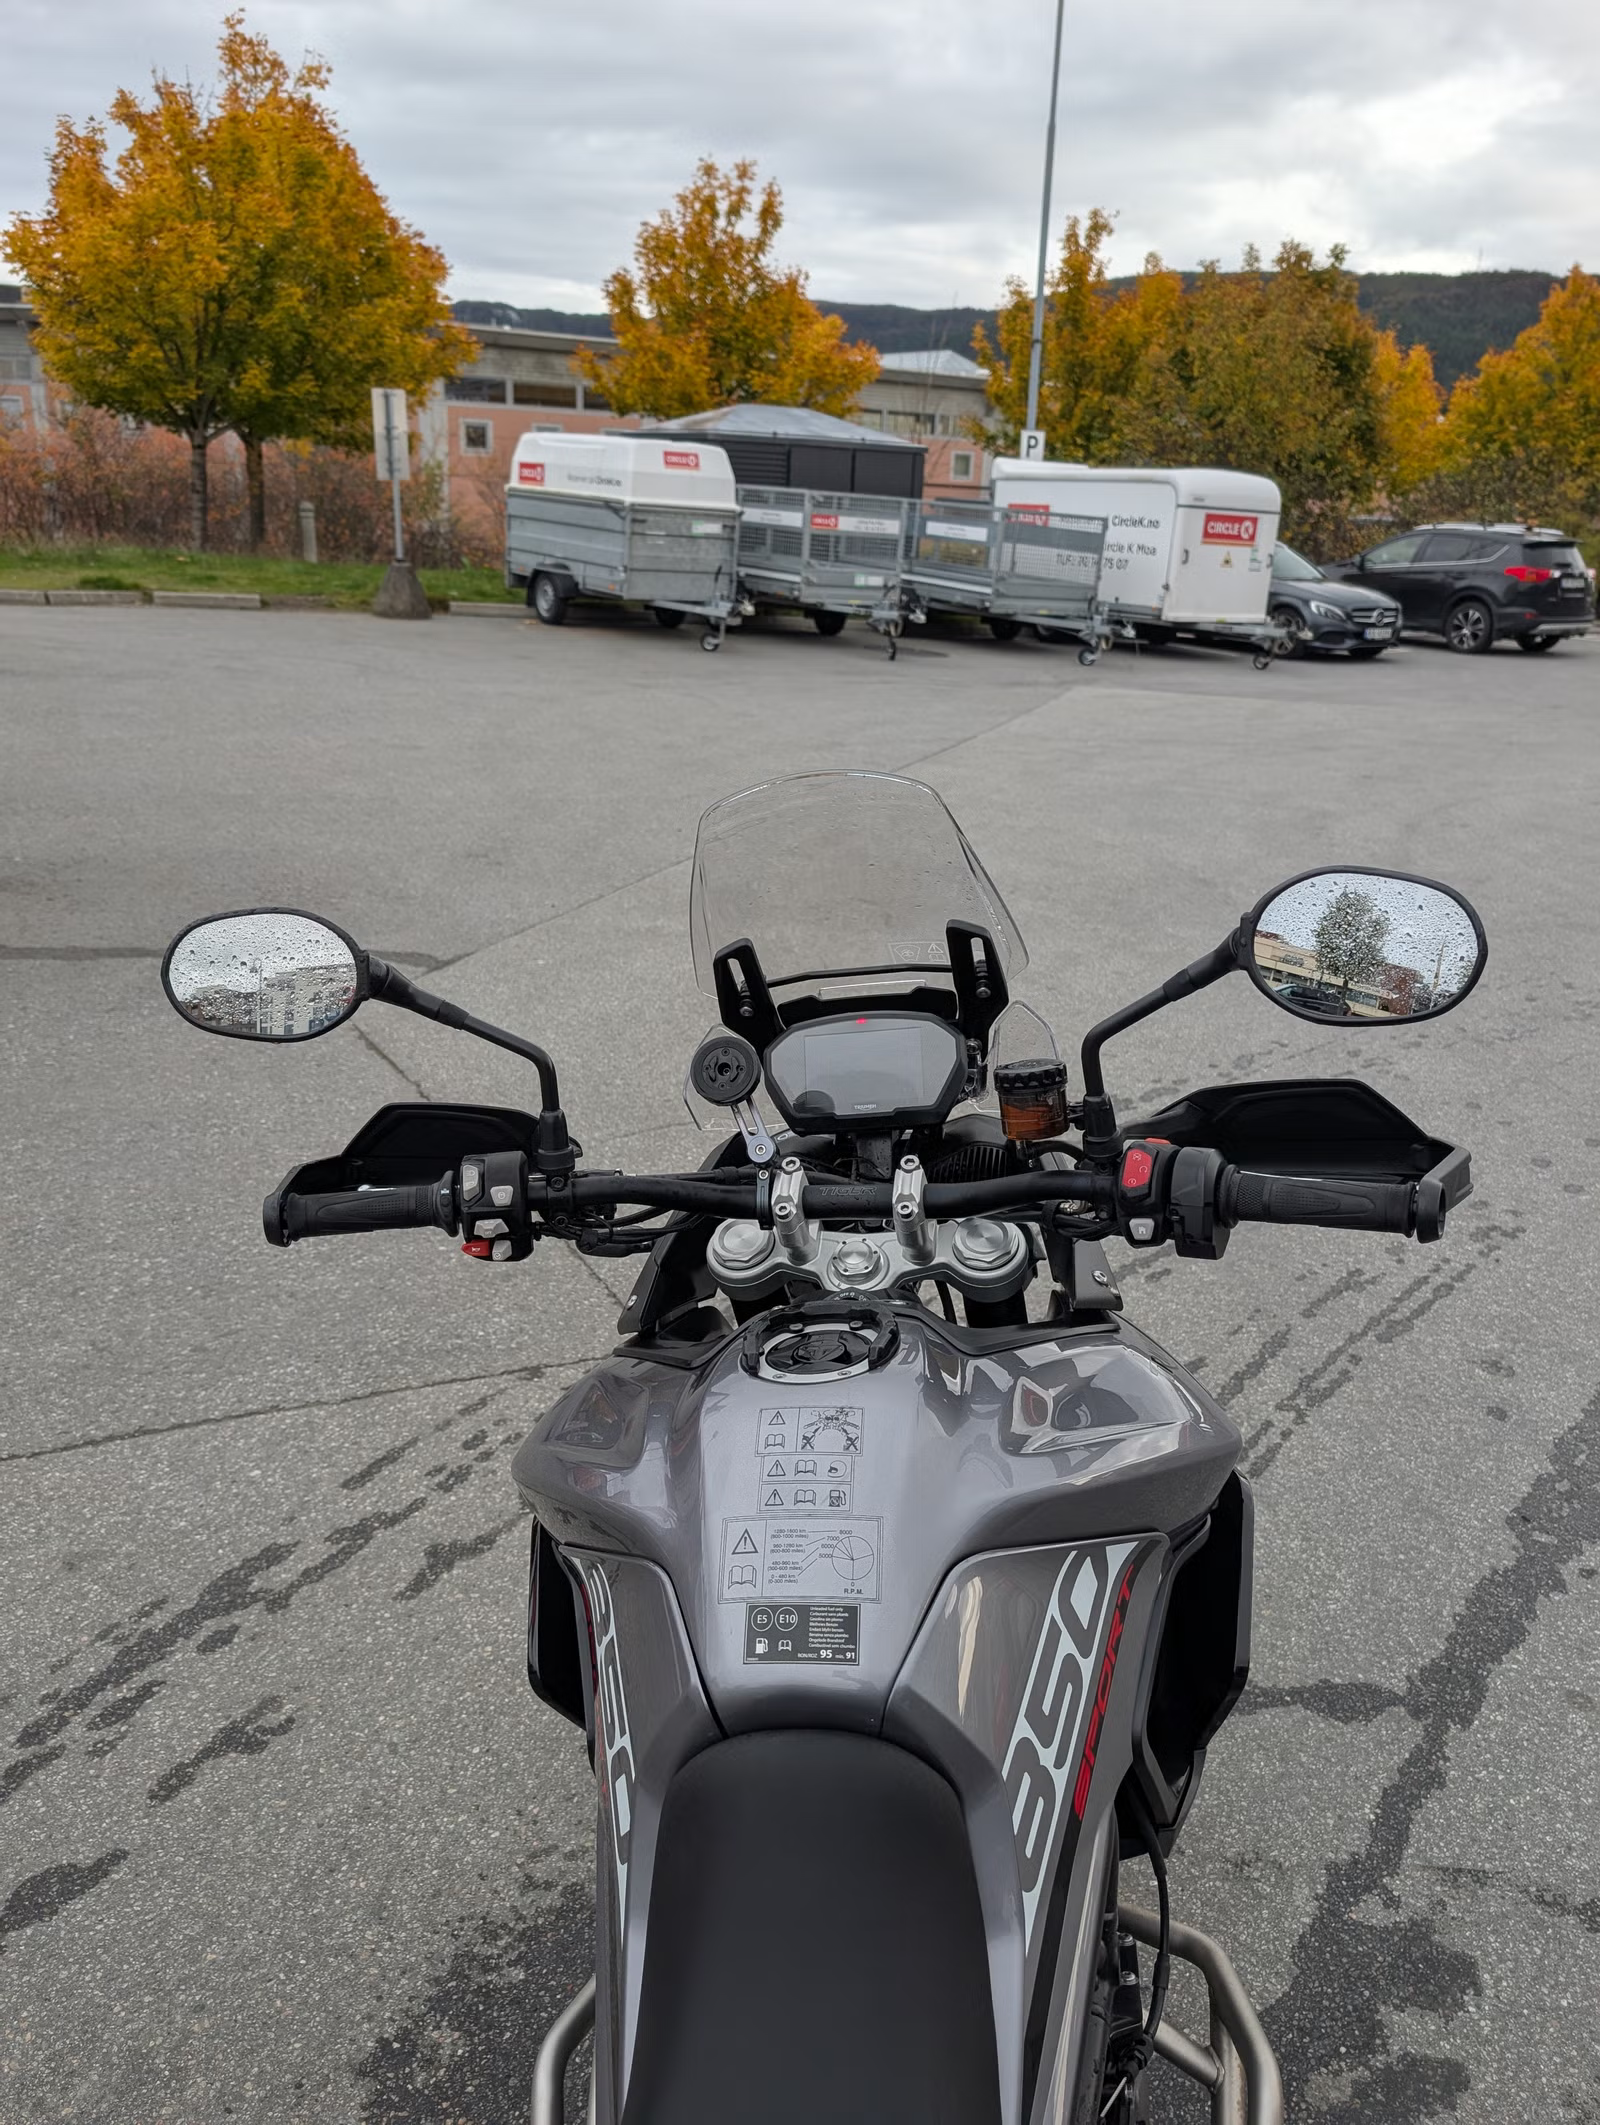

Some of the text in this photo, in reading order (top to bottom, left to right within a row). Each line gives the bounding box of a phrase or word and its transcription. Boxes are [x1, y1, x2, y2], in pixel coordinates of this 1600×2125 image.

[1026, 435, 1039, 458] P
[1207, 521, 1240, 535] CIRCLE
[819, 1186, 877, 1196] TIGER
[757, 1614, 768, 1624] E5
[779, 1614, 796, 1624] E10
[820, 1649, 833, 1659] 95
[845, 1651, 855, 1660] 91
[1073, 1562, 1135, 1822] SPORT
[1003, 1546, 1108, 1893] 850
